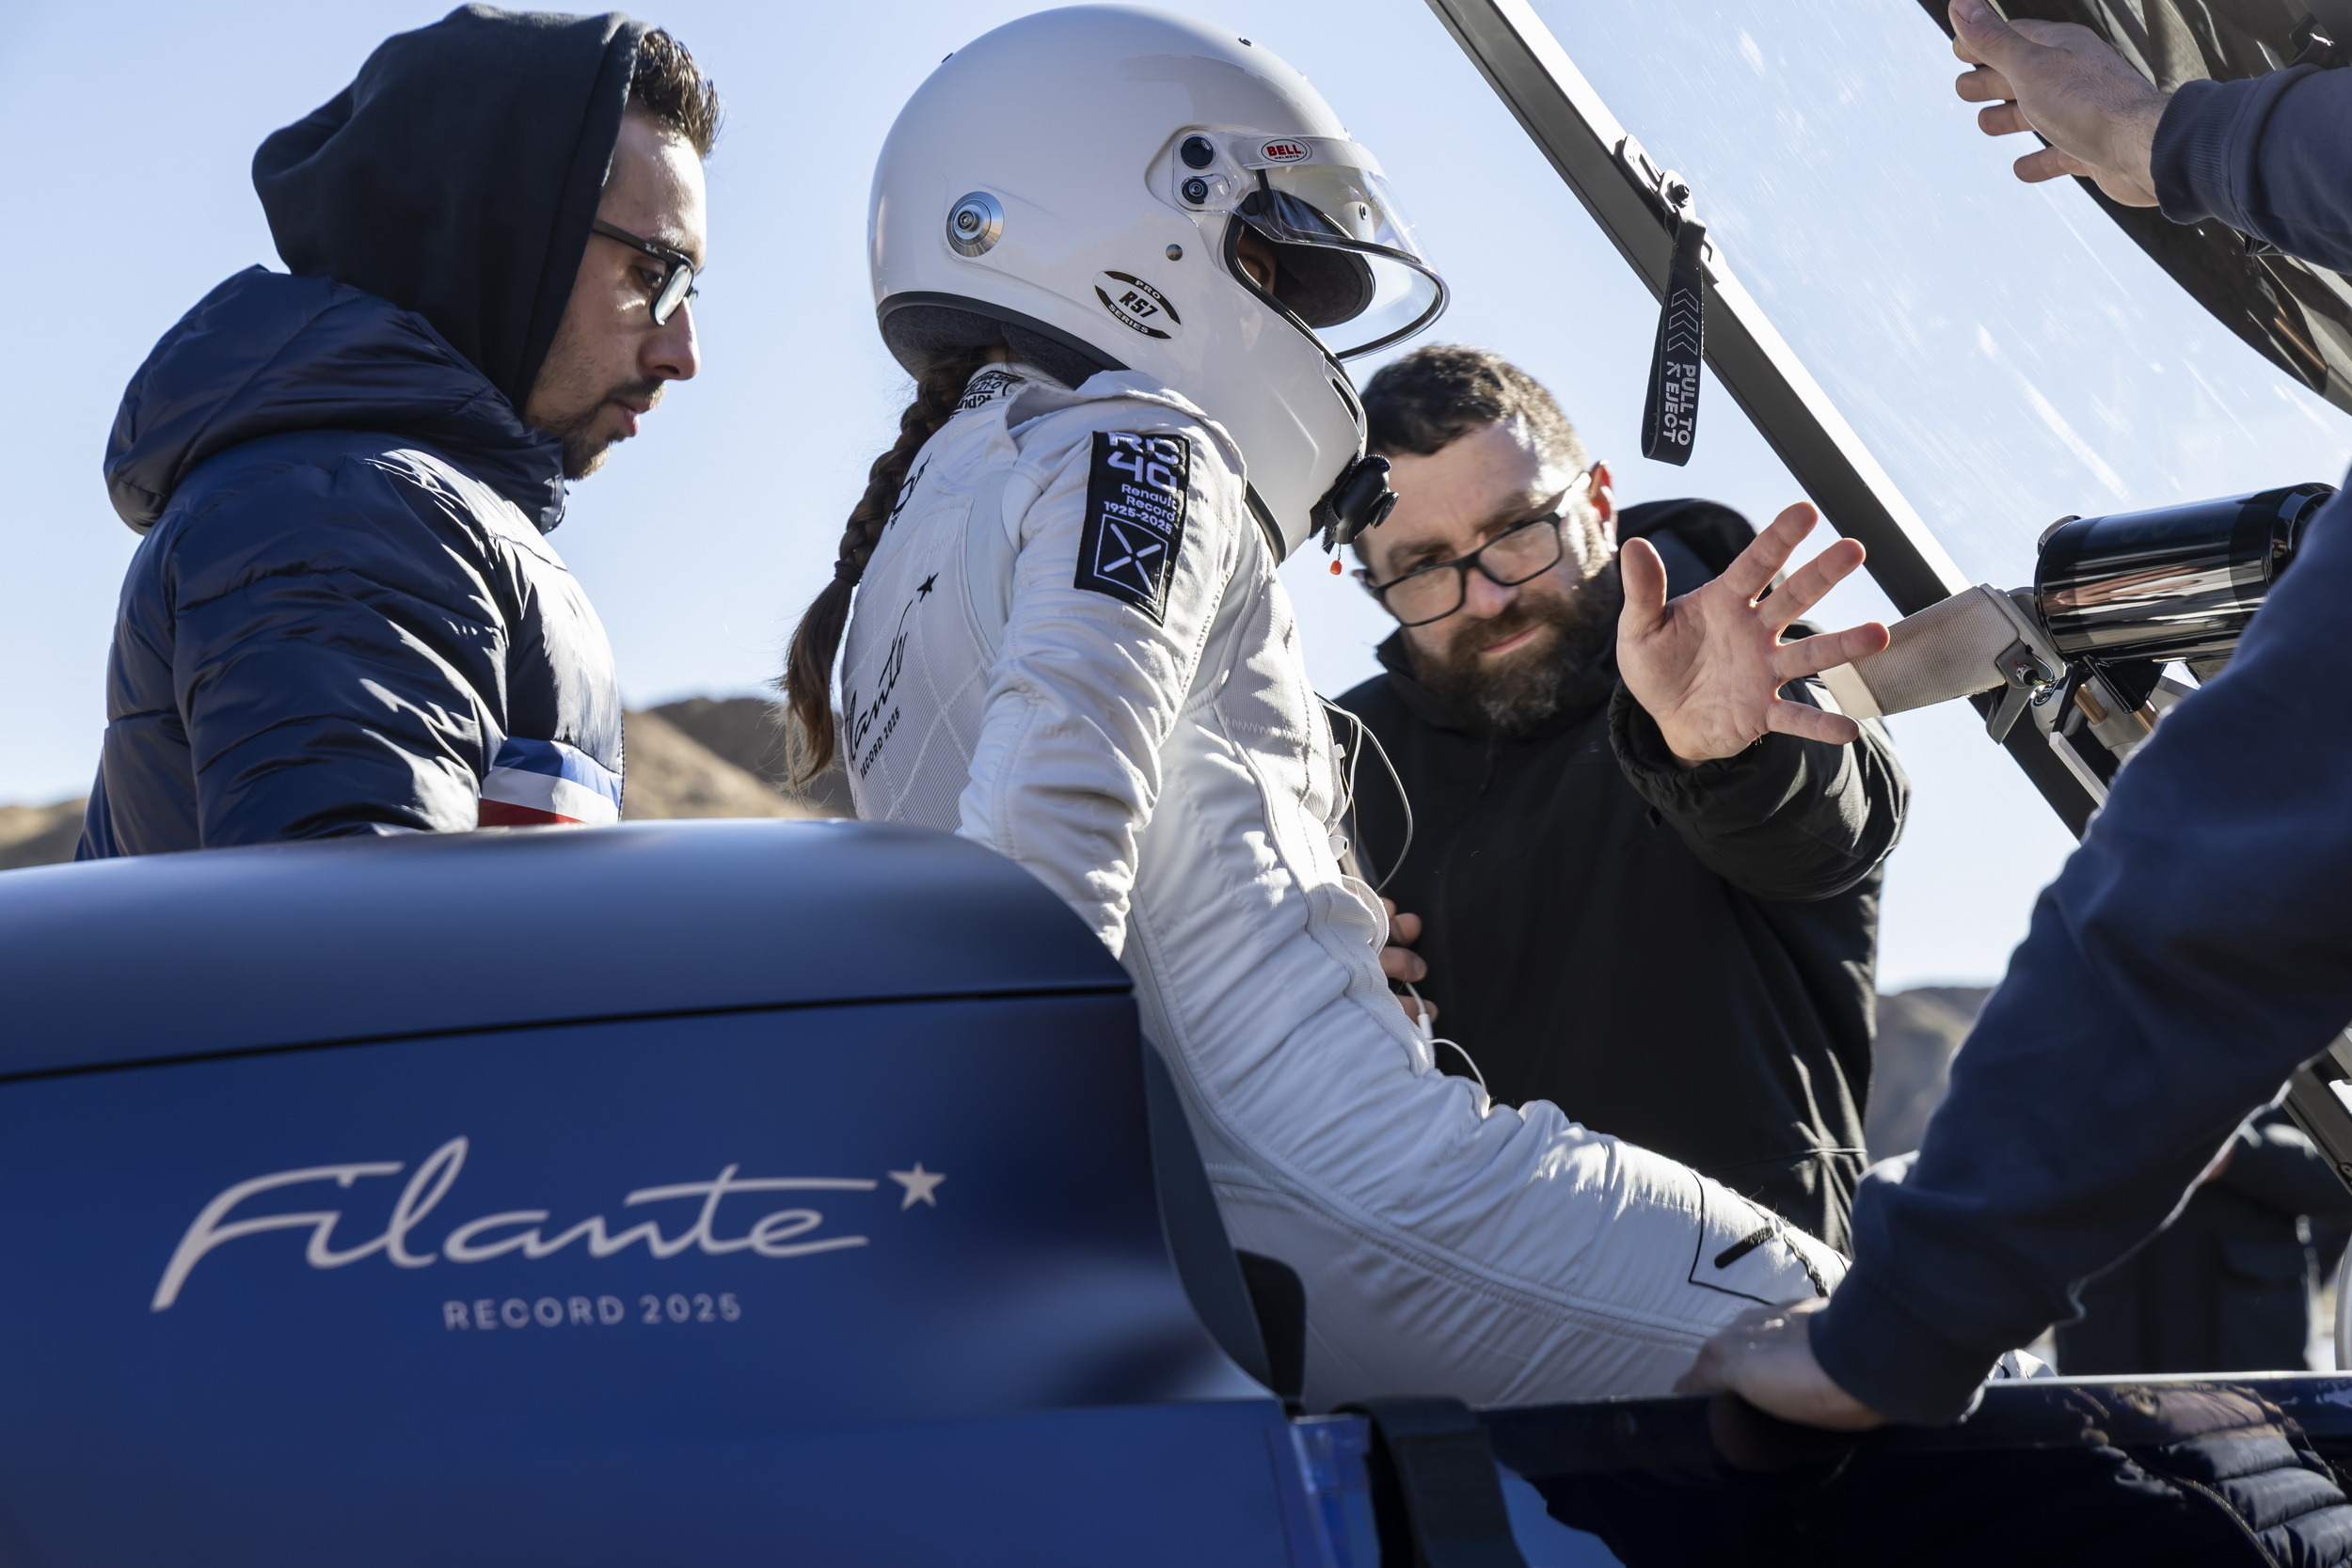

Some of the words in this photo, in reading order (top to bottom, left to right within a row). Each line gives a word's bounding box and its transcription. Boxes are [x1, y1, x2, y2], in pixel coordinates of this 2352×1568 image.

[1266, 144, 1302, 157] BELL
[1119, 290, 1158, 318] RS7
[1135, 279, 1161, 300] PRO
[1108, 303, 1149, 334] SERIES
[1679, 363, 1696, 413] PULL
[1662, 381, 1680, 443] EJECT
[1677, 418, 1692, 446] TO
[1107, 451, 1178, 494] 40
[1121, 483, 1177, 510] Renault
[1126, 495, 1176, 523] Record
[1104, 500, 1173, 535] 1925-2025
[883, 706, 900, 740] 2025
[151, 1135, 879, 1312] Filante
[442, 1295, 625, 1331] RECORD
[639, 1292, 741, 1324] 2025
